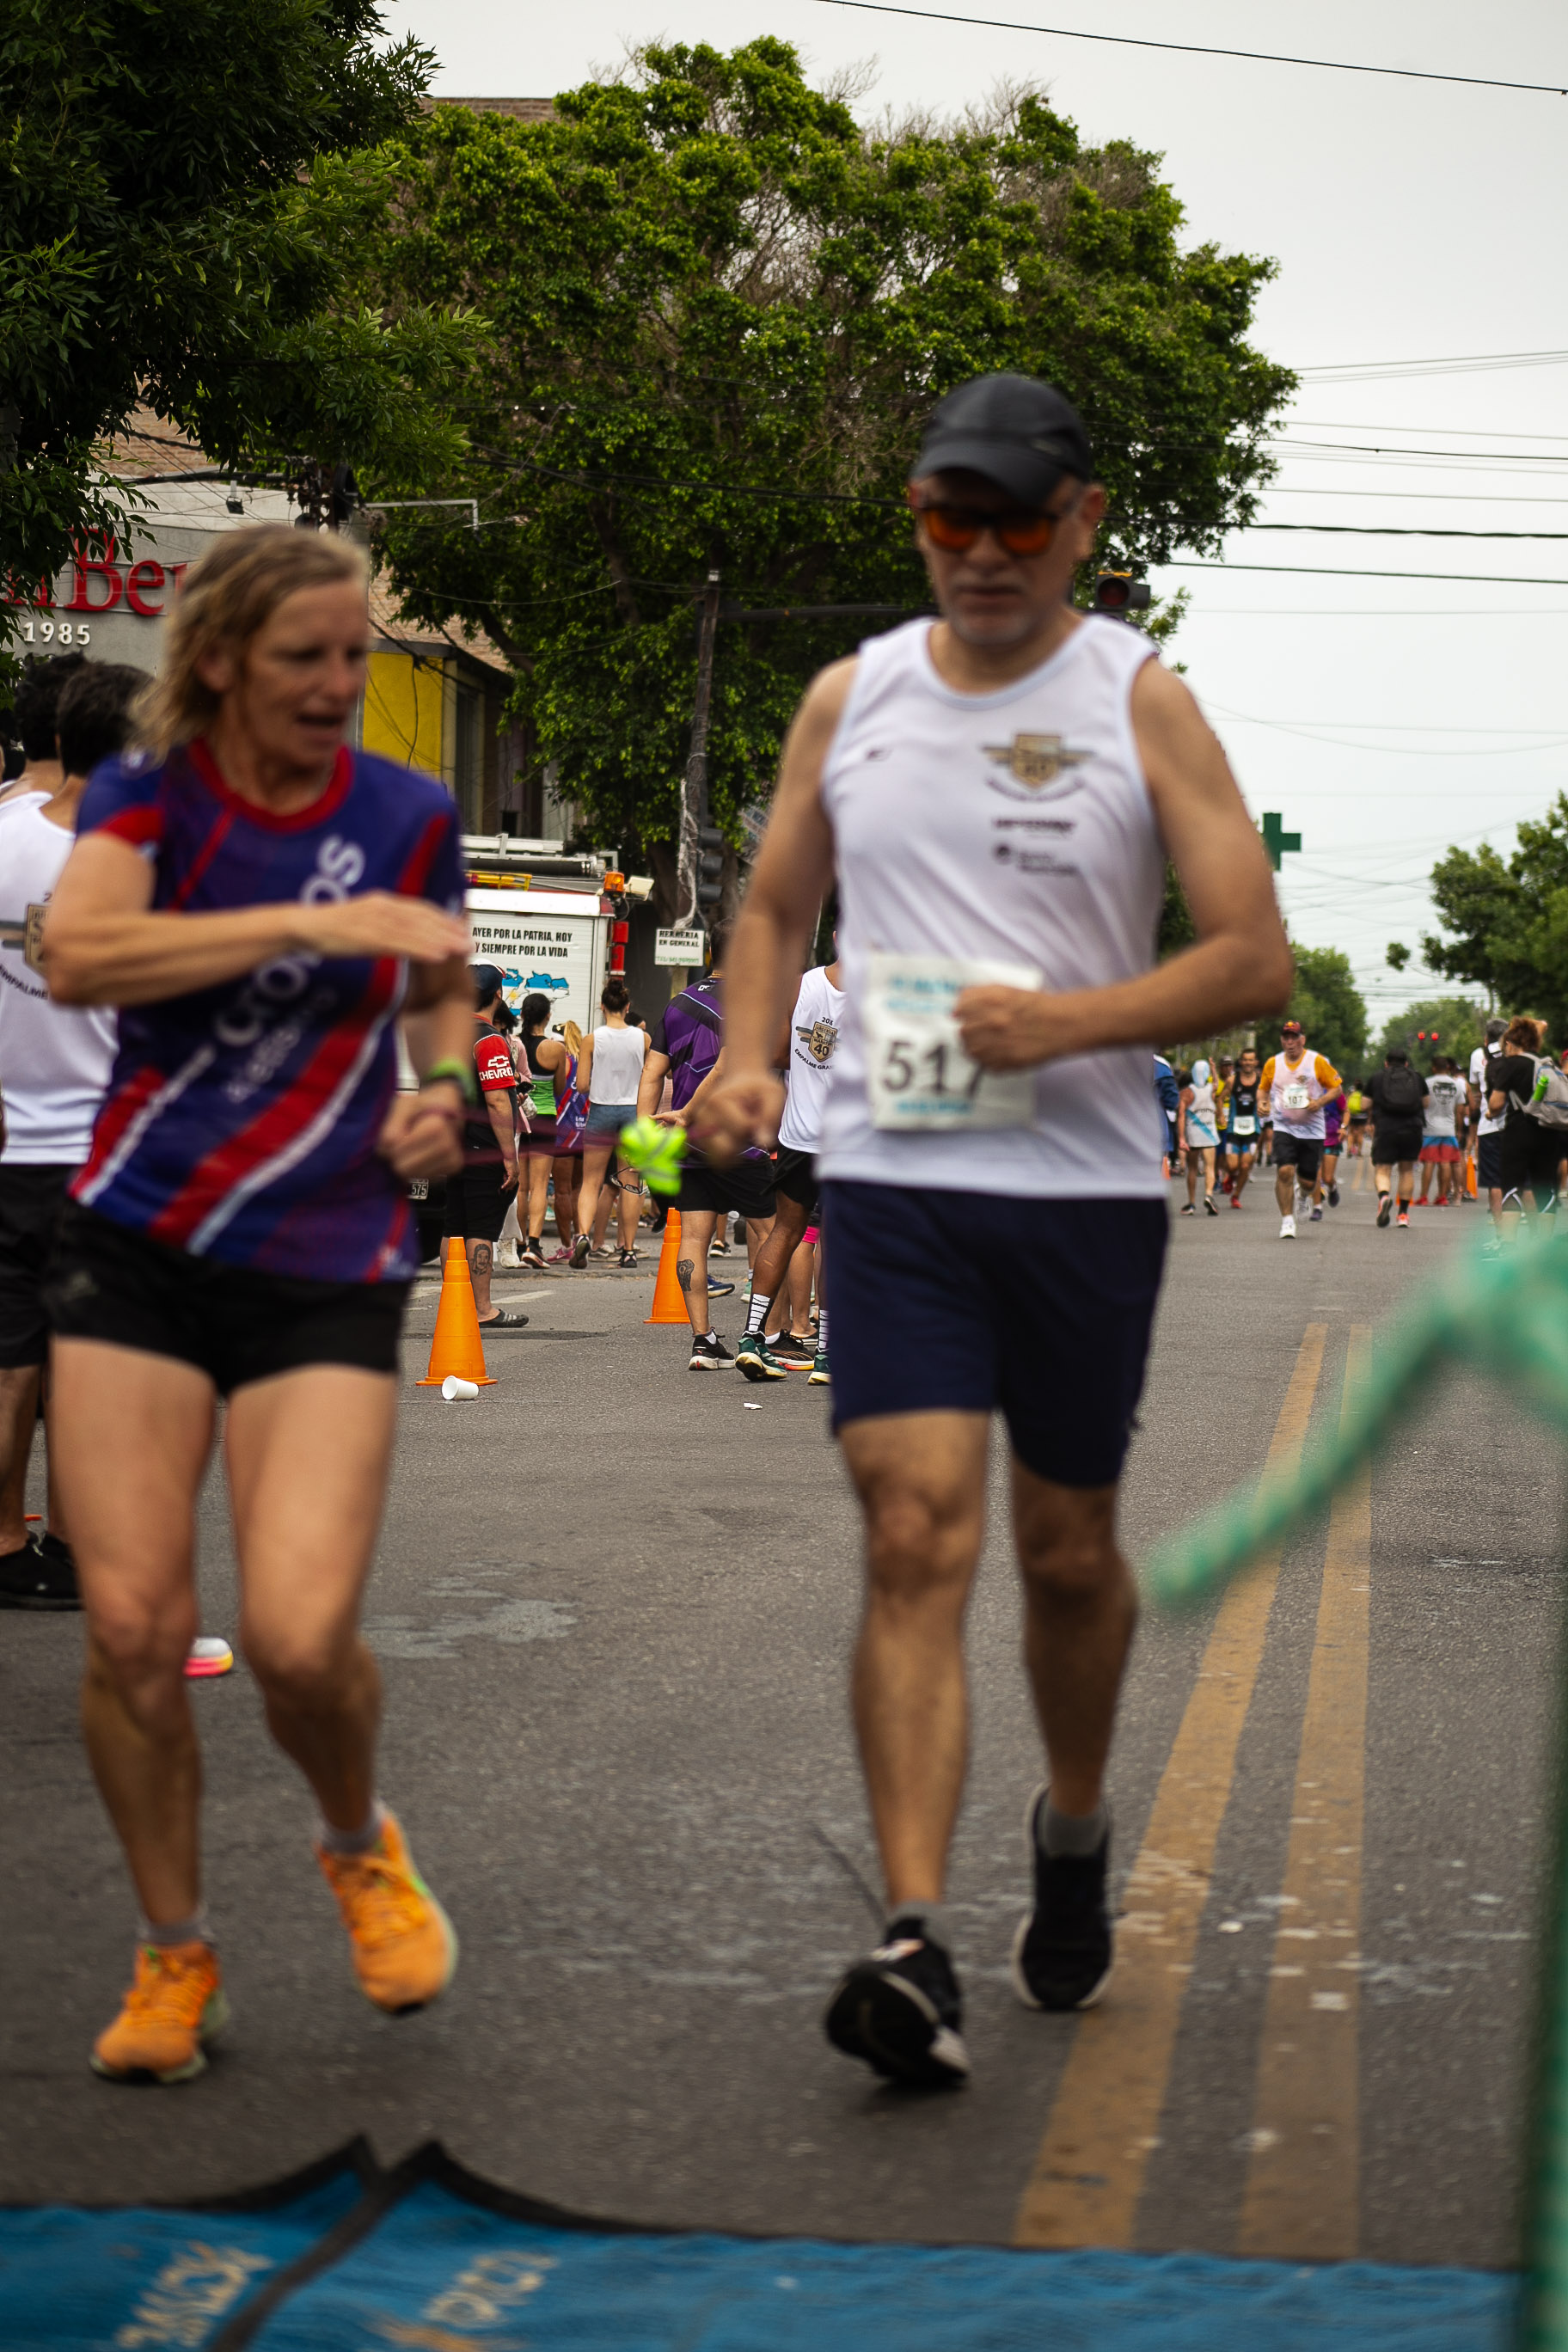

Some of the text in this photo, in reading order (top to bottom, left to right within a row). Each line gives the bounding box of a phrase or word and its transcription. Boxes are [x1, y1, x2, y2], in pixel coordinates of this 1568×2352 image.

[23, 622, 90, 645] 1985
[472, 928, 573, 943] AYER POR LA PATRIA, HOY
[475, 942, 568, 958] Y SIEMPRE POR LA VIDA
[814, 1044, 829, 1056] 40
[794, 1048, 816, 1069] EMPALME
[412, 1183, 427, 1196] 575
